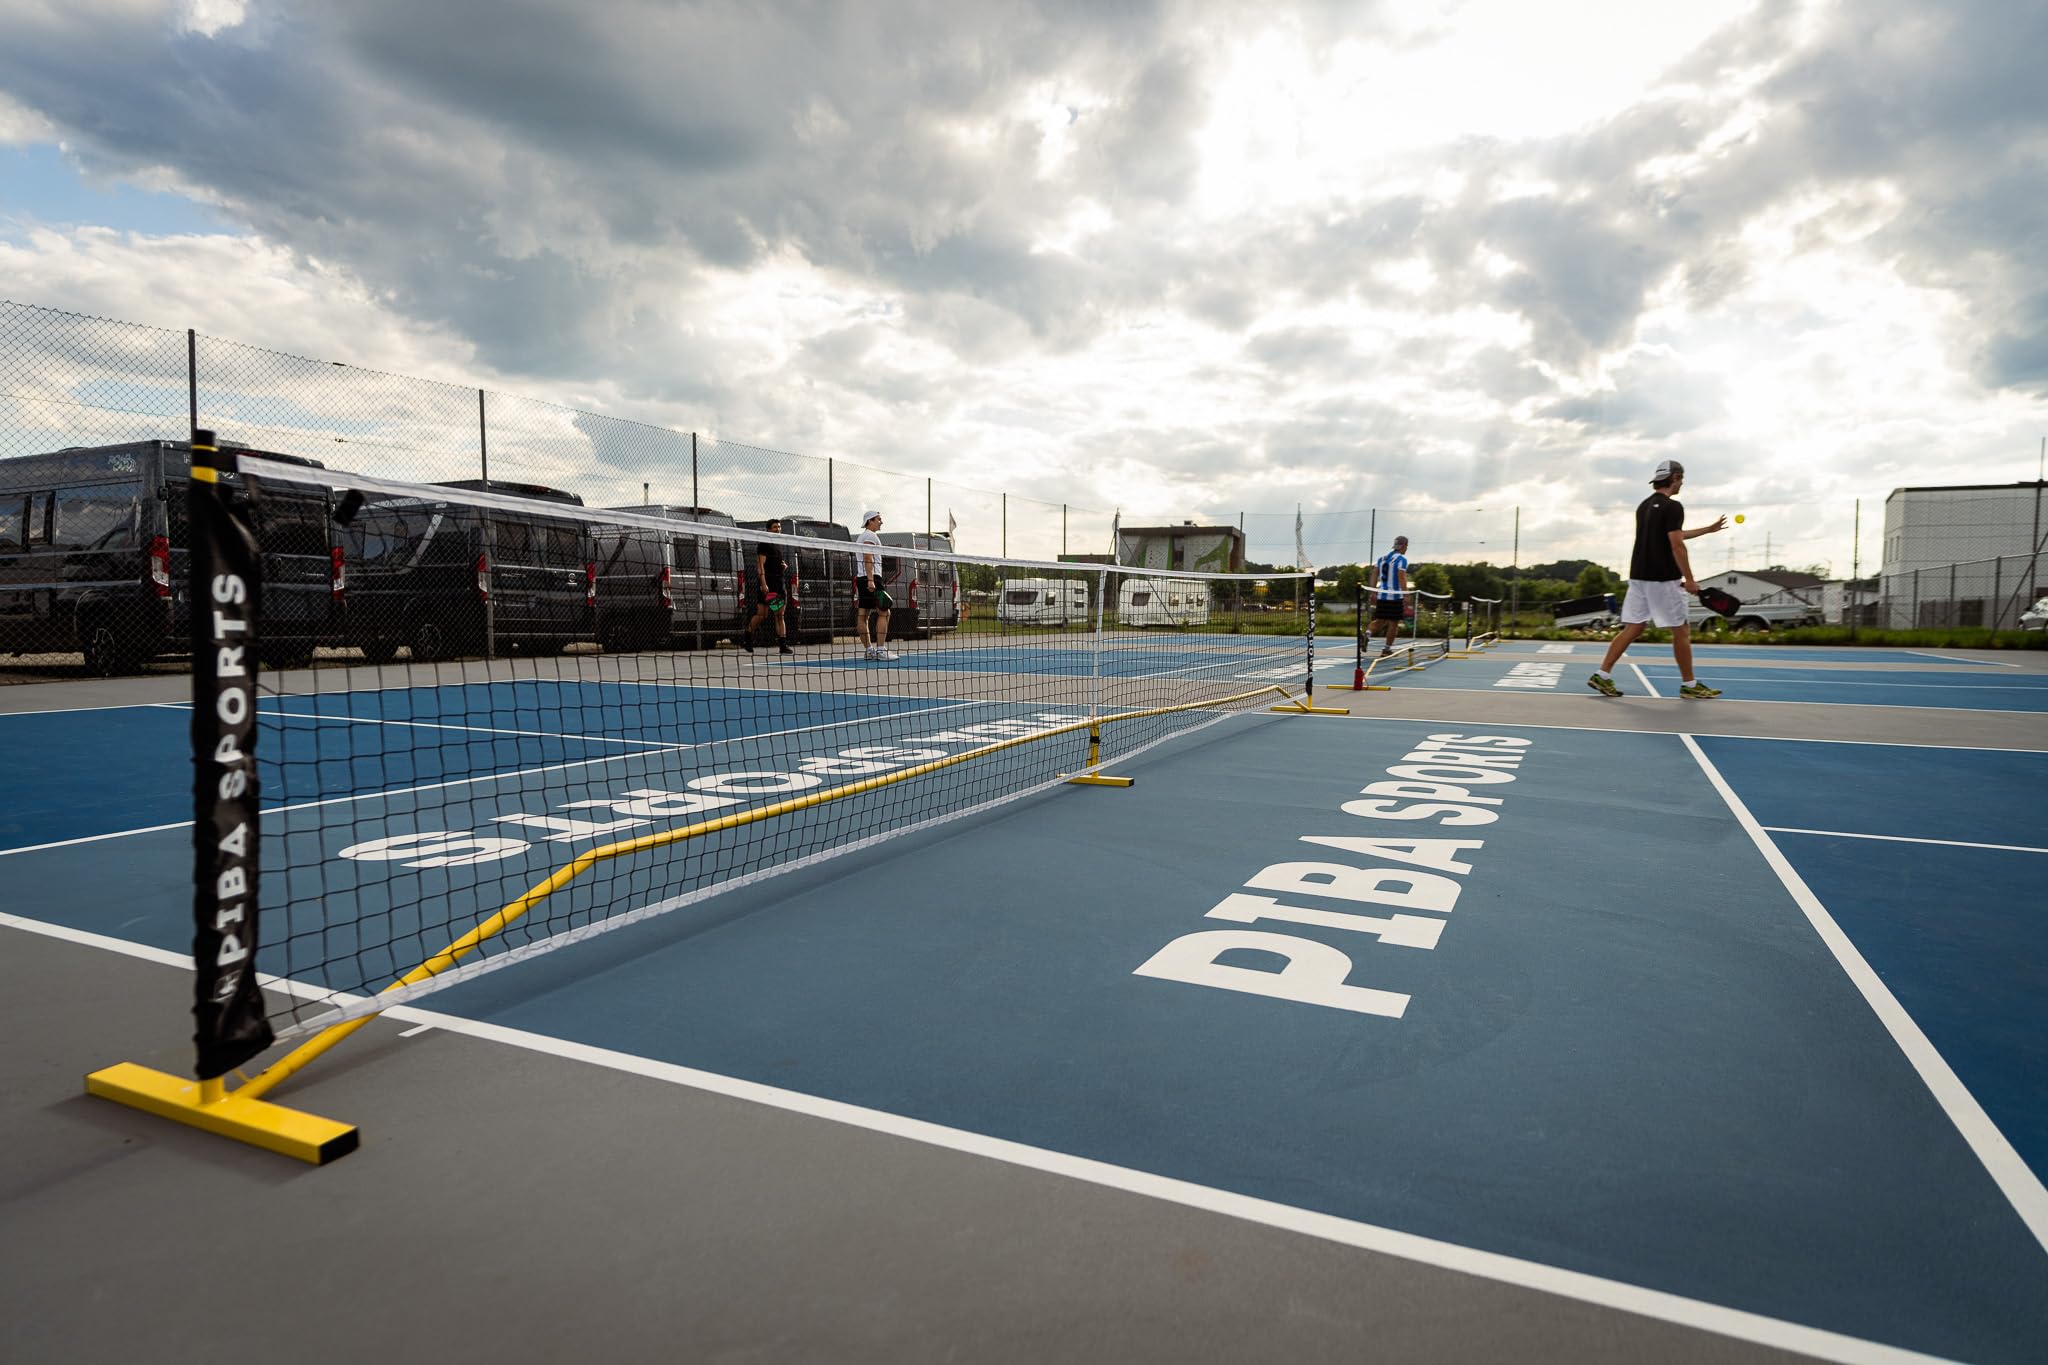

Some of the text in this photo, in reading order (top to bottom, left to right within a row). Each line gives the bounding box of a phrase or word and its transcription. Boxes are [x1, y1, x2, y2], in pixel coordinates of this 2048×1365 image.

[211, 574, 248, 967] PIBA SPORTS
[338, 745, 949, 868] SPORTS
[1131, 835, 1485, 1019] PIBA
[1340, 733, 1533, 826] SPORTS
